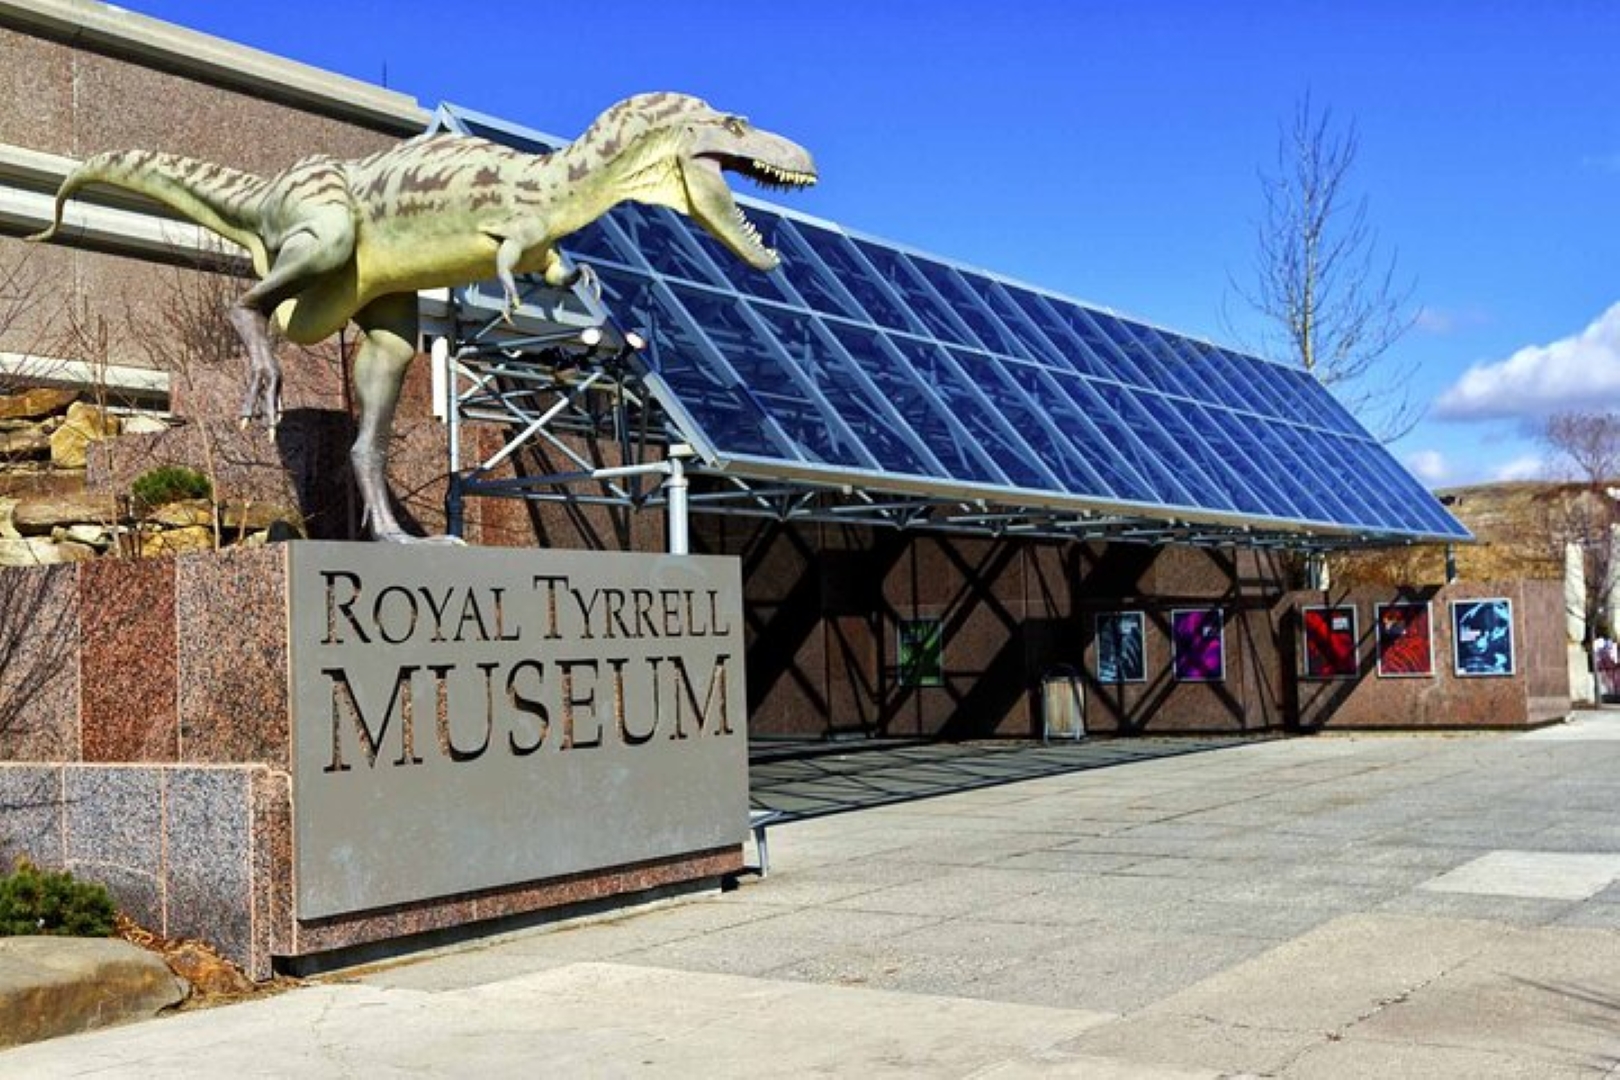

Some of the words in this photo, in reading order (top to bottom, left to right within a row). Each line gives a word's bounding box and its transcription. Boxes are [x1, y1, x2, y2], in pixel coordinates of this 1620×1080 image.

[320, 570, 520, 645] ROYAL
[533, 575, 730, 640] TYRRELL
[321, 654, 734, 773] MUSEUM
